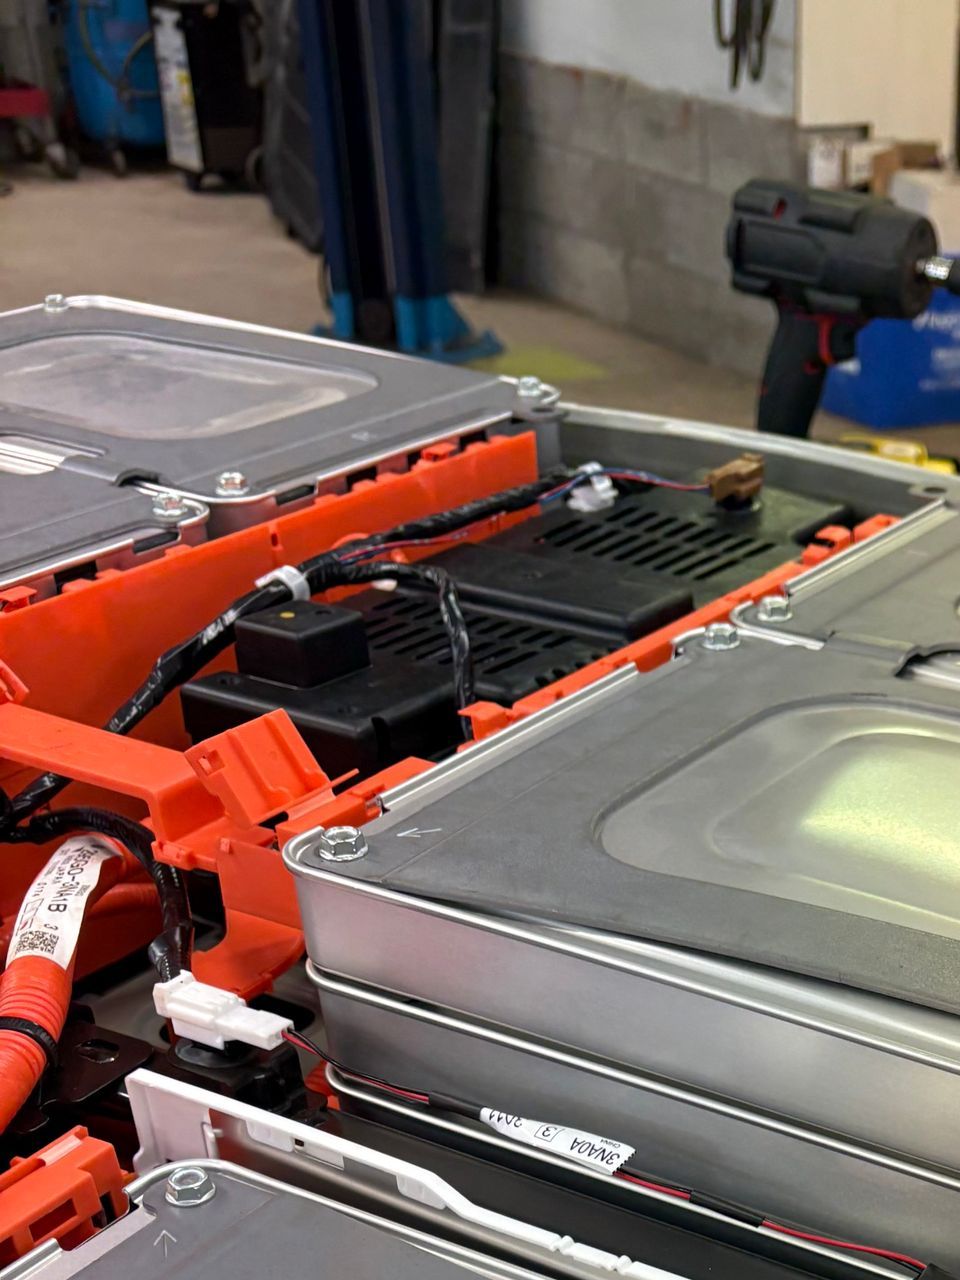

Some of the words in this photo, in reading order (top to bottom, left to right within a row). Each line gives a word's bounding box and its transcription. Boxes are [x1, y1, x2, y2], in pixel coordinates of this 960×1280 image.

[542, 1126, 557, 1138] 3
[600, 1138, 621, 1149] CHINA
[570, 1137, 620, 1166] 3NA0A
